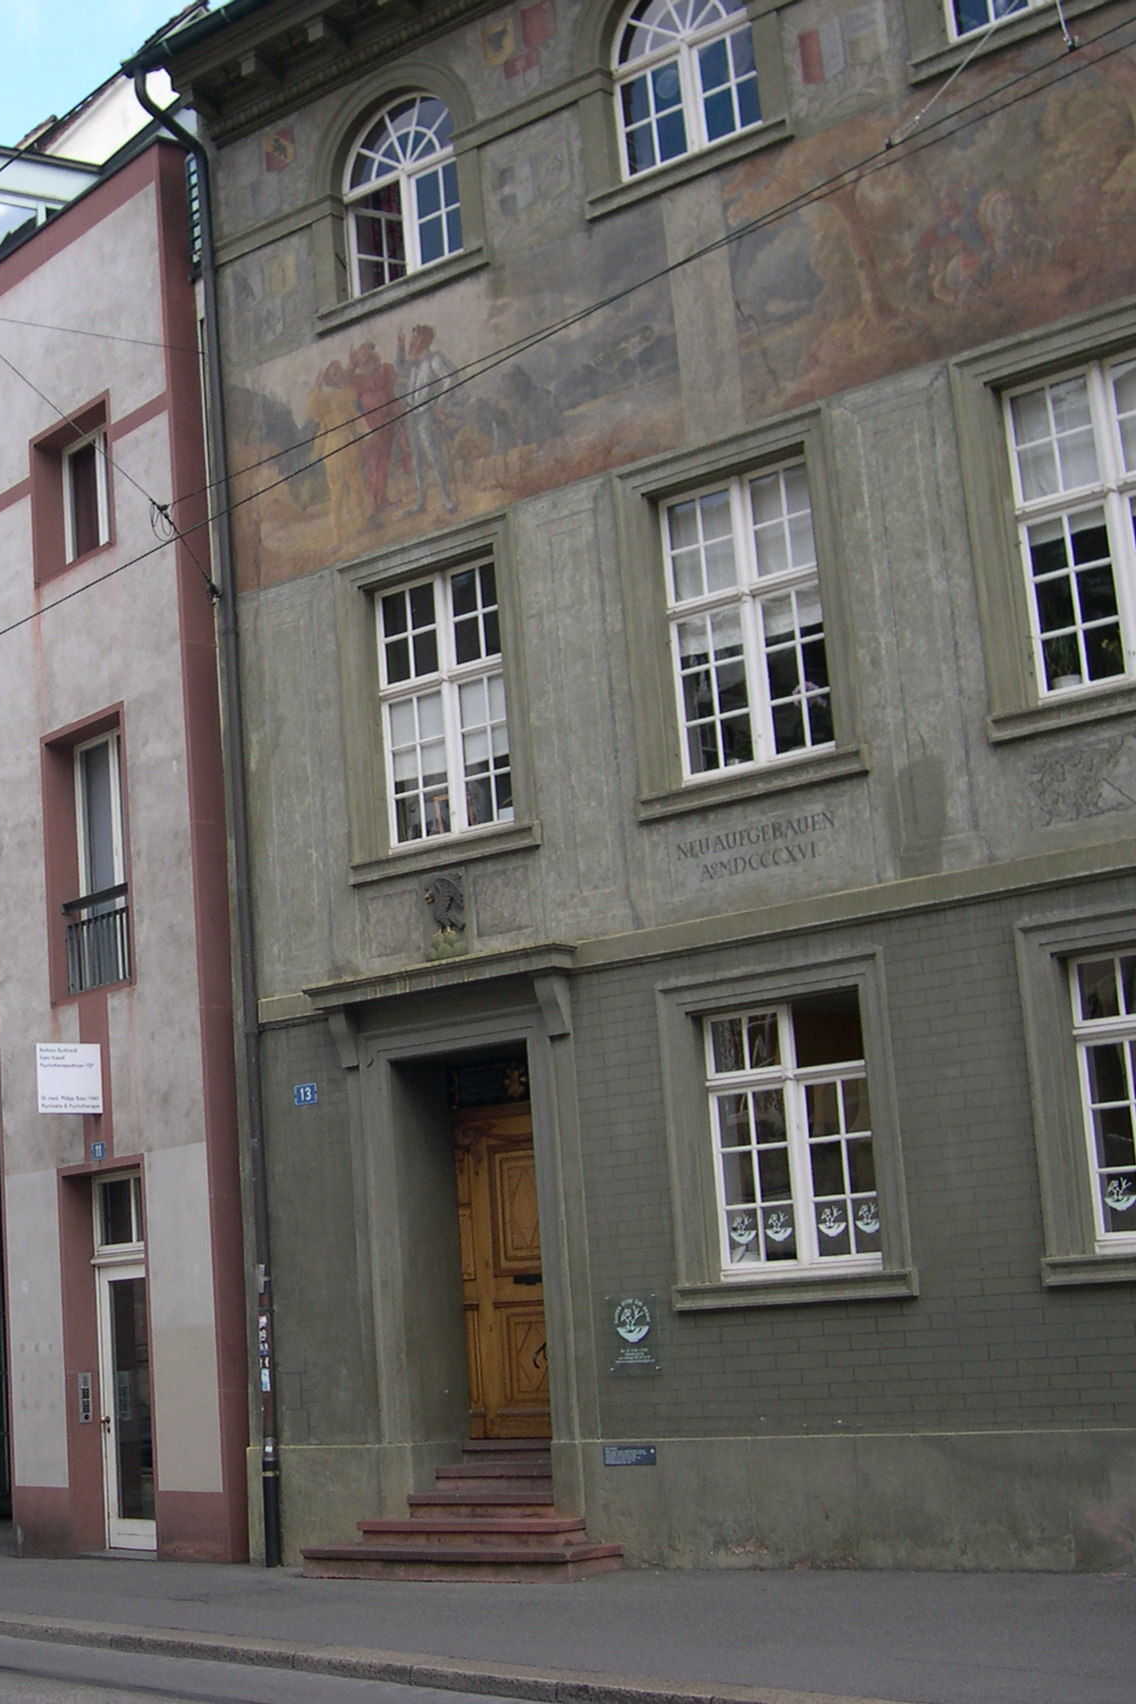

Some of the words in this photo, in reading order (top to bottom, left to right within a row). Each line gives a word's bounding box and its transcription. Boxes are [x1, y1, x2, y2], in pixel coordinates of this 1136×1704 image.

[676, 837, 710, 861] NEU
[713, 810, 836, 852] AUFGEBAUEN
[299, 1086, 312, 1101] 13
